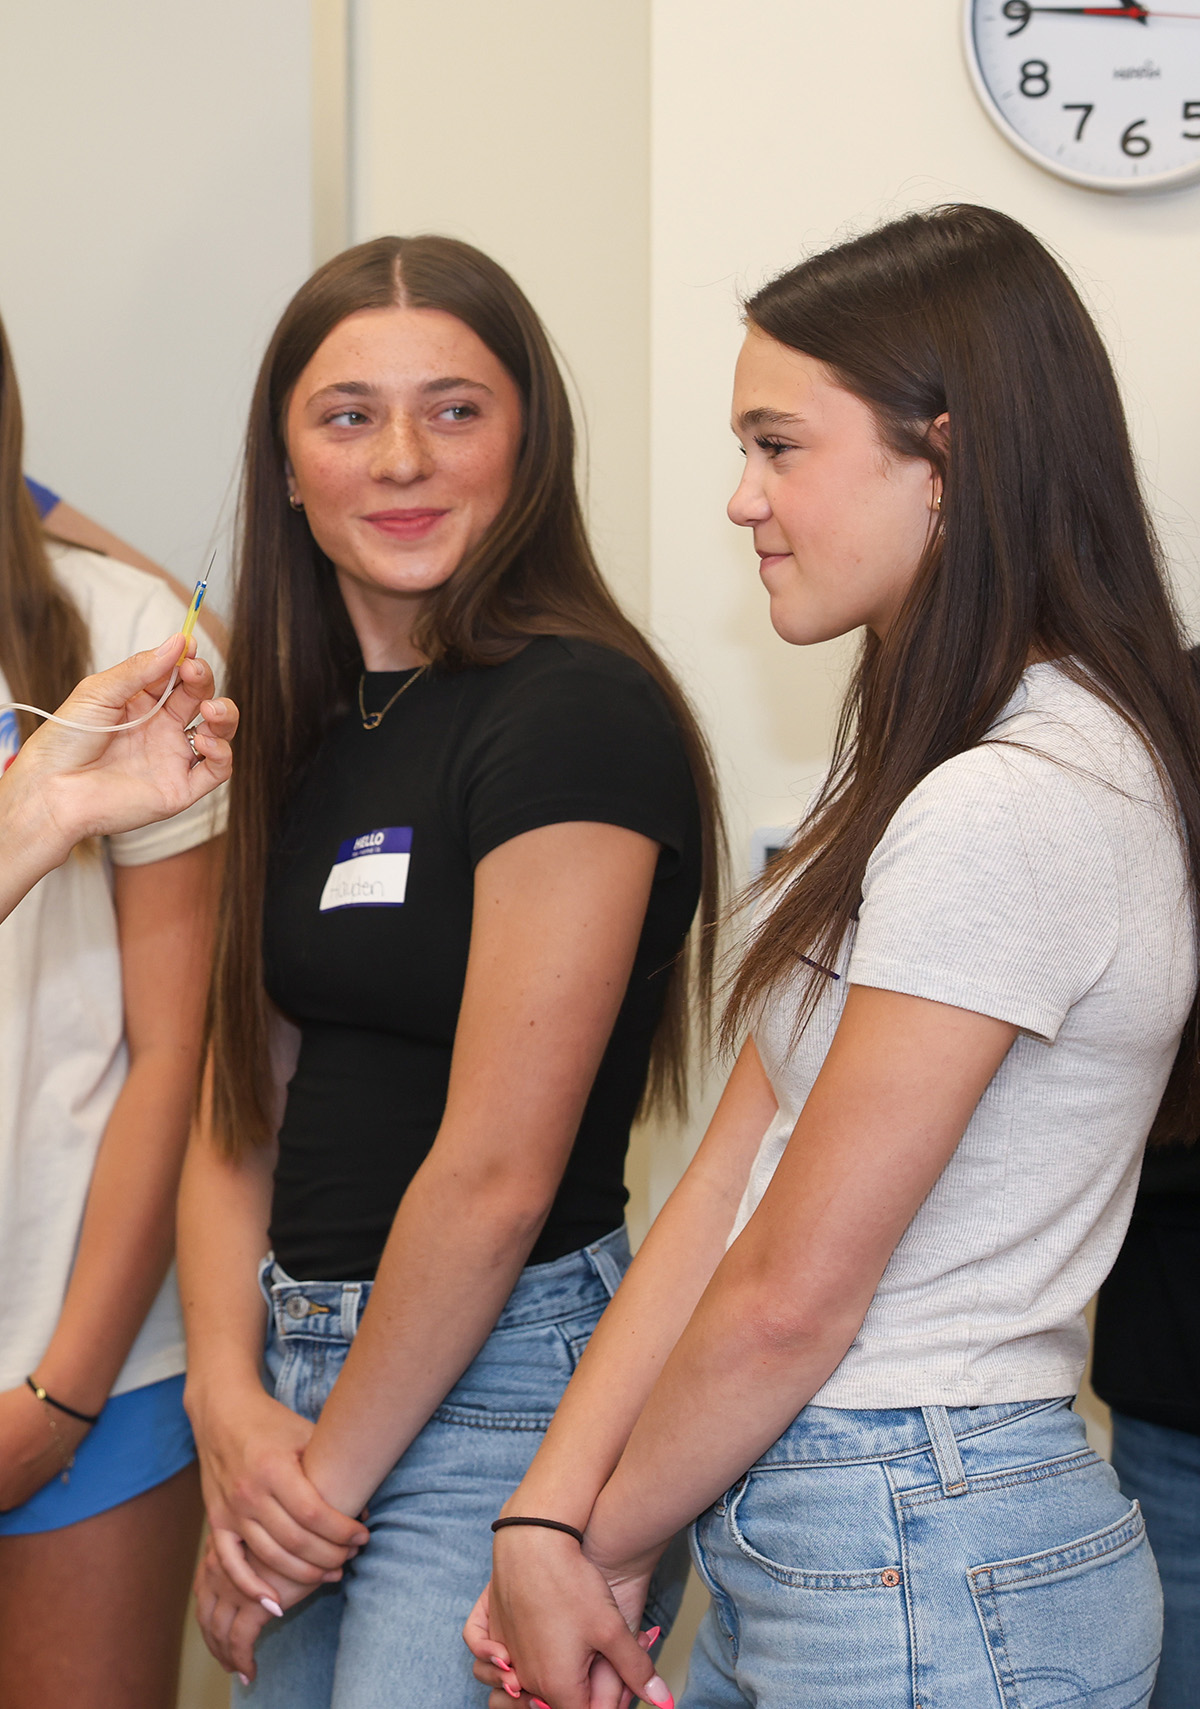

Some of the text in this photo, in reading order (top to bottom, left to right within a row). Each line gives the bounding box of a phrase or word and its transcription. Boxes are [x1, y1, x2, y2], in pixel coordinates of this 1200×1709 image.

[1002, 0, 1032, 38] 9
[1019, 60, 1050, 98] 8
[1063, 103, 1094, 141] 7
[1120, 119, 1152, 157] 6
[1183, 101, 1200, 139] 5
[353, 831, 385, 850] HELLO
